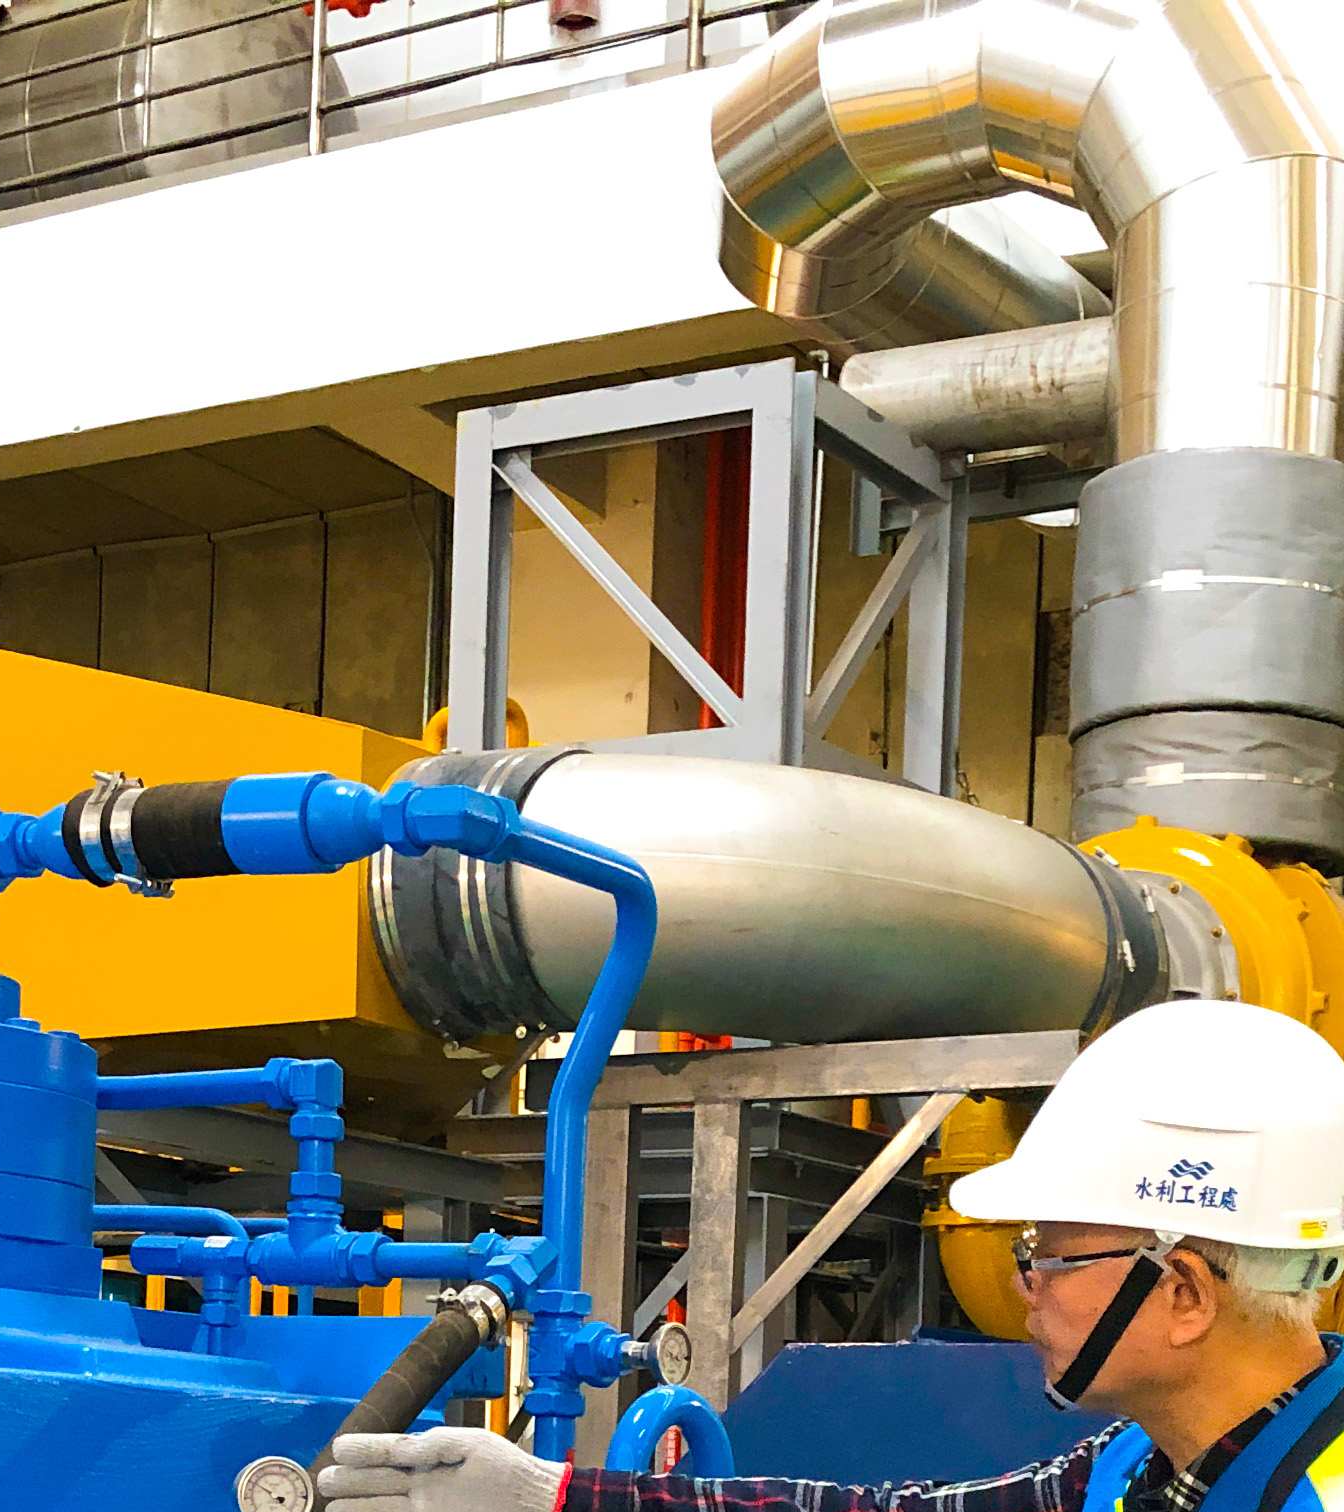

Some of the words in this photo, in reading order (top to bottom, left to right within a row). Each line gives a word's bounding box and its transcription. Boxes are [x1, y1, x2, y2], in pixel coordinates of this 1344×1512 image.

[1135, 1176, 1238, 1212] 水利工程處
